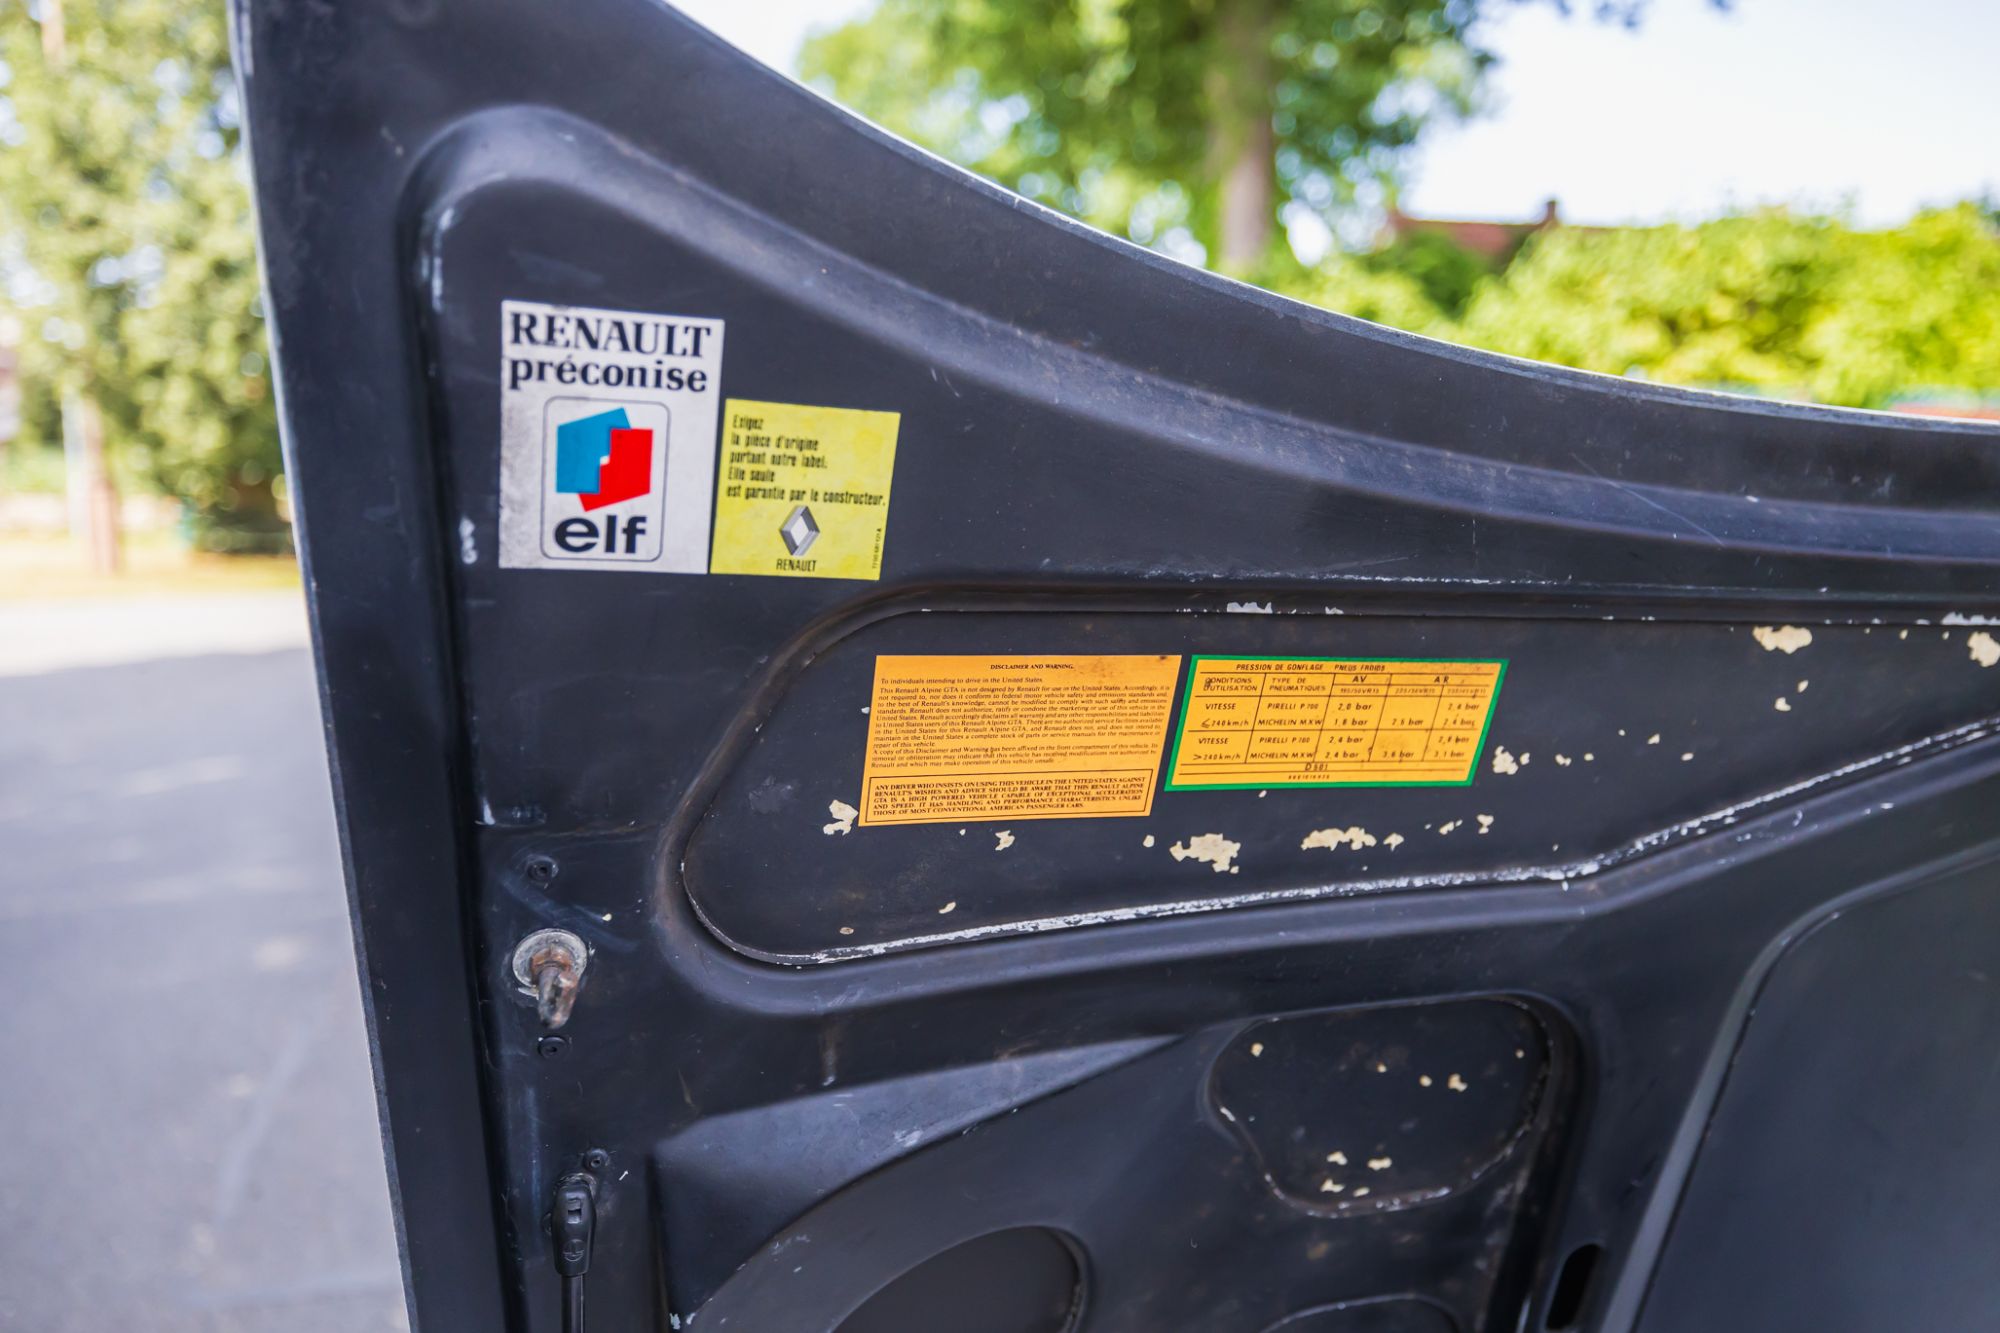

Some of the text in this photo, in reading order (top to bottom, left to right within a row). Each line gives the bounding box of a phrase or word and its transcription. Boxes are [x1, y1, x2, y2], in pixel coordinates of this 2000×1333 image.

[510, 312, 711, 358] RENAULT
[509, 355, 707, 392] préconise
[732, 433, 739, 445] la
[775, 435, 818, 451] d'origine
[730, 451, 827, 468] portant notre label.
[728, 467, 774, 482] Elle seule
[727, 485, 885, 507] est garantie par le constructeur.
[554, 515, 647, 554] elf
[776, 558, 817, 572] RENAULT
[1352, 718, 1368, 726] bar
[1408, 718, 1424, 726] bar
